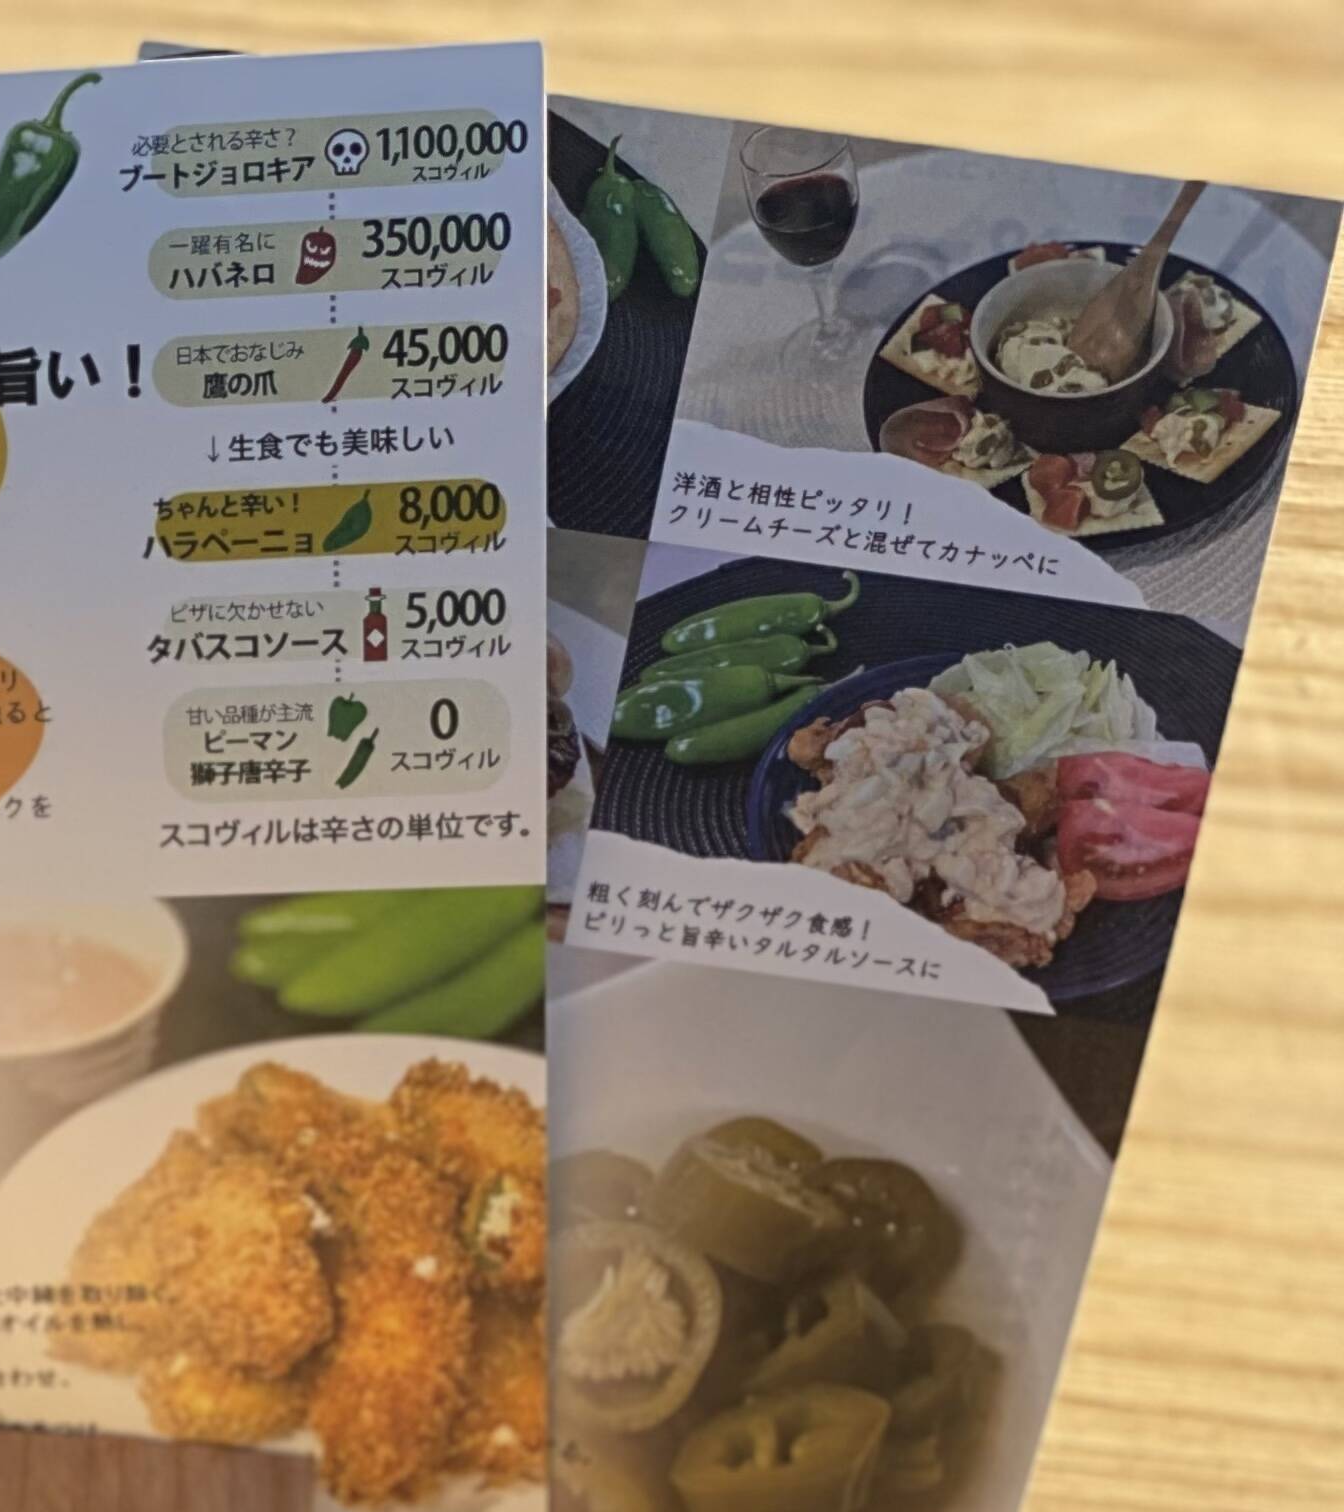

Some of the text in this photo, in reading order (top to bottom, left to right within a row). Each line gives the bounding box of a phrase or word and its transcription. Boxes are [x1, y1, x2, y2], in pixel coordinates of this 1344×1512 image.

[376, 120, 528, 167] 1,100,000
[120, 155, 316, 193] ブートジョロキア
[412, 163, 490, 183] スコヴィル
[168, 231, 276, 256] 一躍有名に
[362, 213, 510, 260] 350,000
[168, 262, 275, 290] ハバネロ
[381, 264, 494, 290] スコヴィル
[176, 343, 304, 366] 日本でおなじみ
[383, 324, 508, 371] 45,000
[203, 371, 278, 400] 鷹の爪
[391, 374, 502, 399] スコヴィル
[153, 493, 300, 521] ちゃんと辛い！
[399, 484, 500, 529] 8,000
[672, 471, 913, 526] 洋酒と相性ピッタリ！
[142, 528, 312, 560] ハラペーニョ
[395, 532, 506, 555] スコヴィル
[669, 505, 1060, 576] クリームチーズと混ぜてカナッペに
[170, 600, 324, 623] ピザに欠かせない
[405, 588, 506, 632] 5,000
[147, 628, 348, 663] タバスコソース
[400, 636, 510, 659] スコヴィル
[186, 703, 314, 725] 甘い品種が主流
[429, 697, 458, 740] 0
[204, 730, 297, 753] ピーマン
[190, 760, 311, 786] 獅子唐辛子
[391, 749, 500, 772] スコヴィル
[160, 812, 530, 849] スコヴィルは辛さの単位です。
[587, 881, 871, 942] 粗く刻んでザクザク食感！
